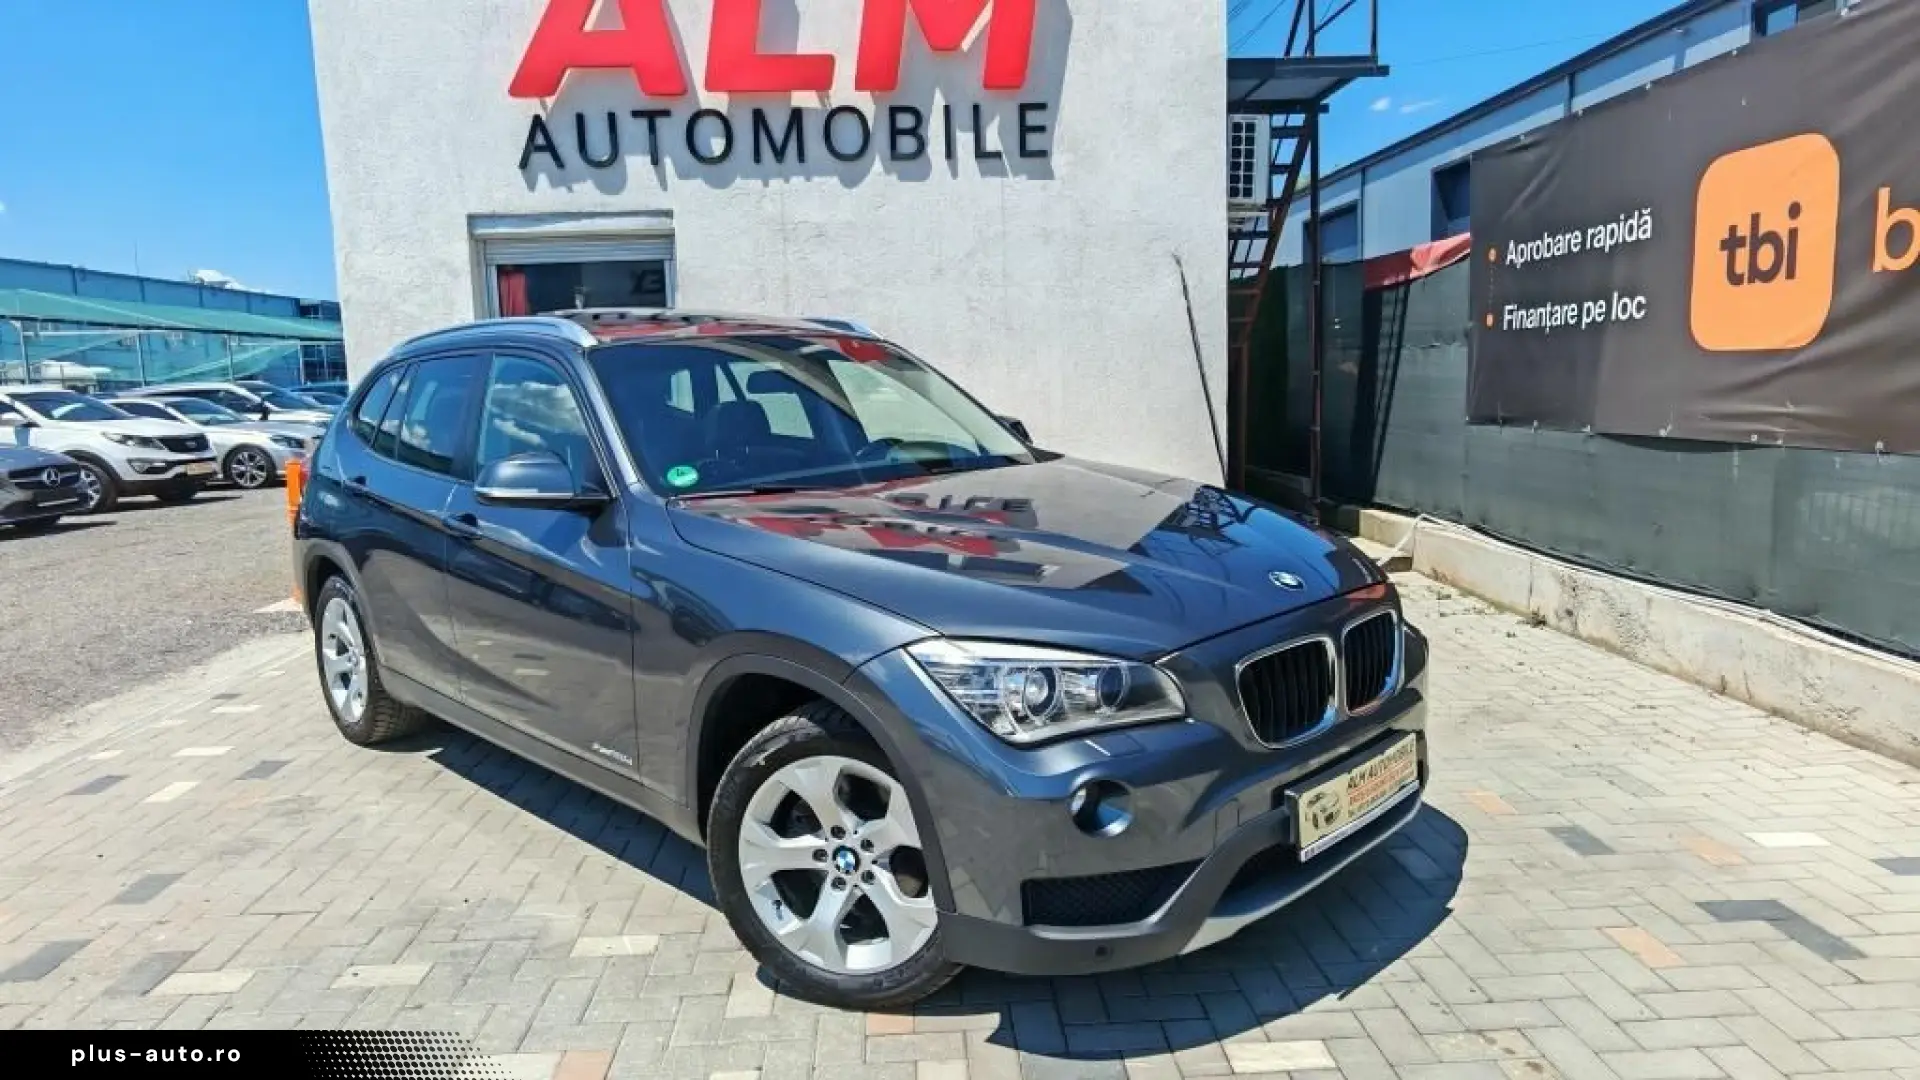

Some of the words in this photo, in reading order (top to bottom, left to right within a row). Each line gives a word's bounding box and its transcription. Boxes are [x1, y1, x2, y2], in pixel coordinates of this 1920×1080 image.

[508, 0, 1036, 97] ALM
[518, 102, 1050, 170] AUTOMOBILE
[1505, 231, 1582, 269] Aprobare
[1586, 207, 1653, 253] rapidă
[1719, 201, 1802, 286] tbi
[1503, 302, 1578, 334] Finanțare
[1582, 299, 1606, 329] pe
[1611, 290, 1647, 321] loc
